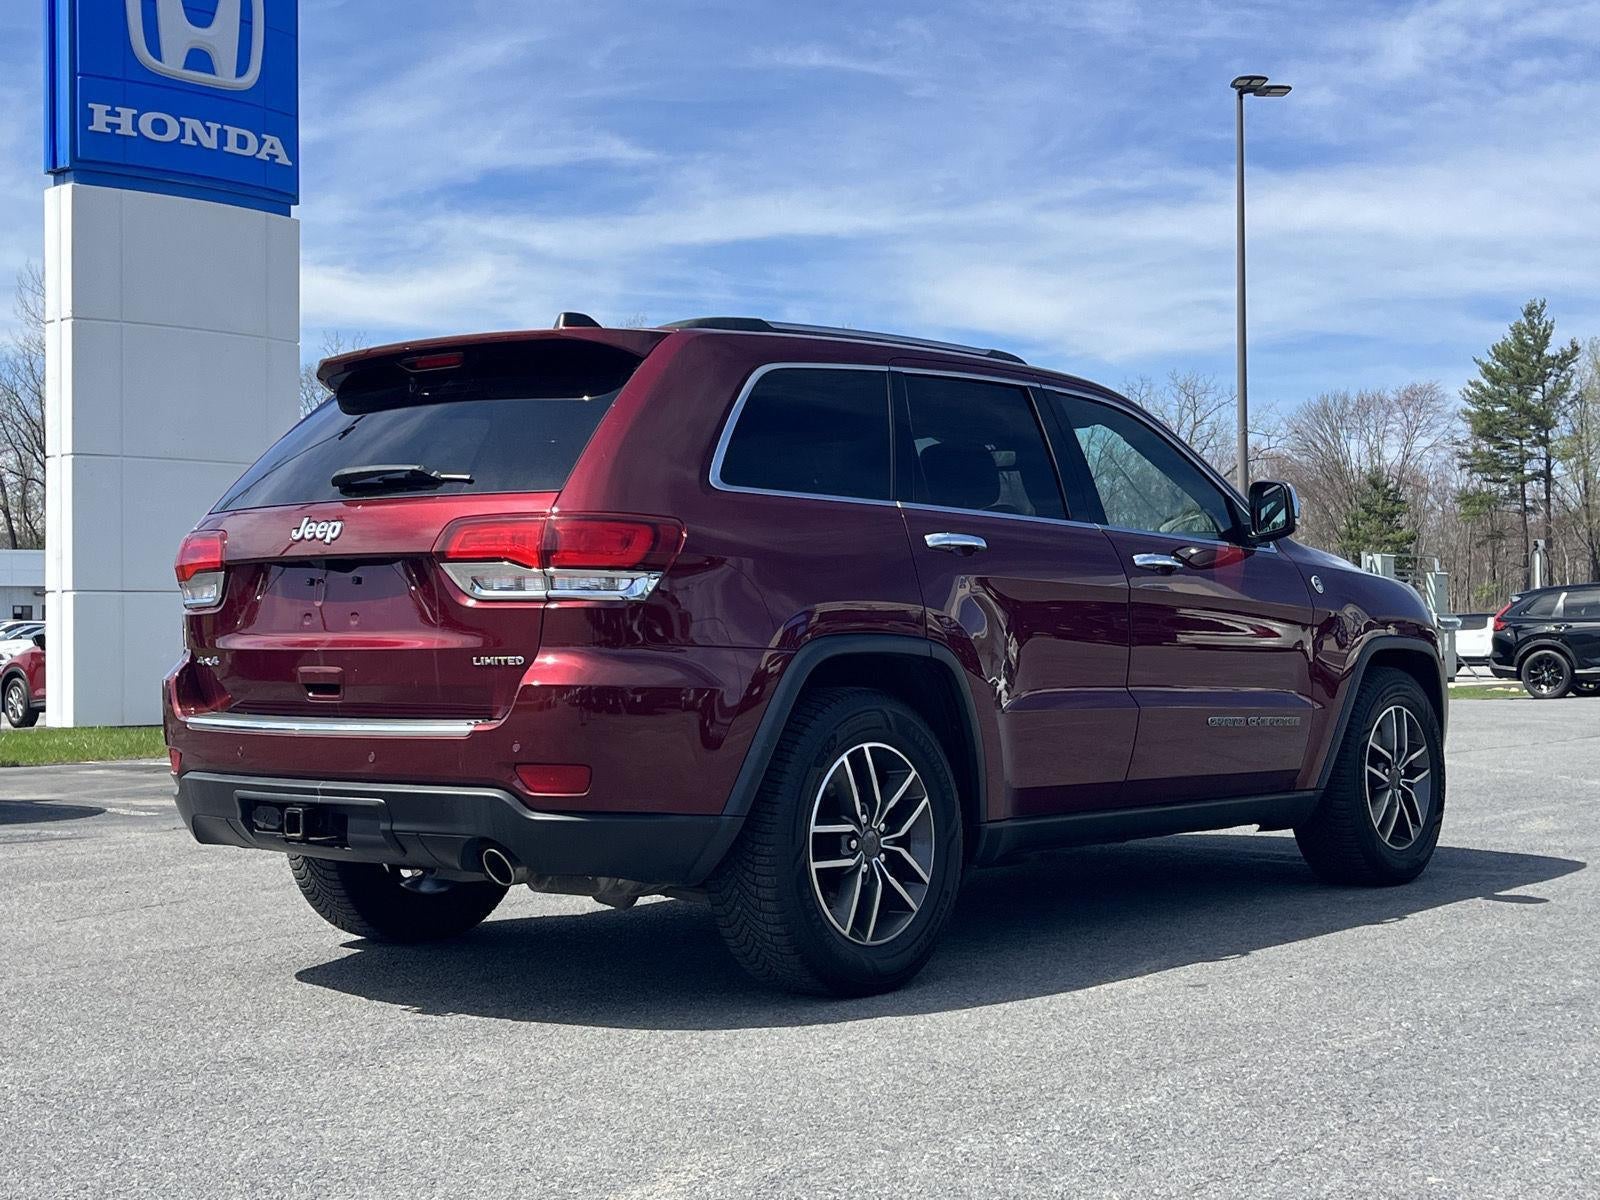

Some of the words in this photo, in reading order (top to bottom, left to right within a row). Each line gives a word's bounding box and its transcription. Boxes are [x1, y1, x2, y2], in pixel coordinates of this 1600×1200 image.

[88, 103, 292, 166] HONDA
[291, 516, 344, 544] Jeep
[472, 655, 525, 666] LIMITED
